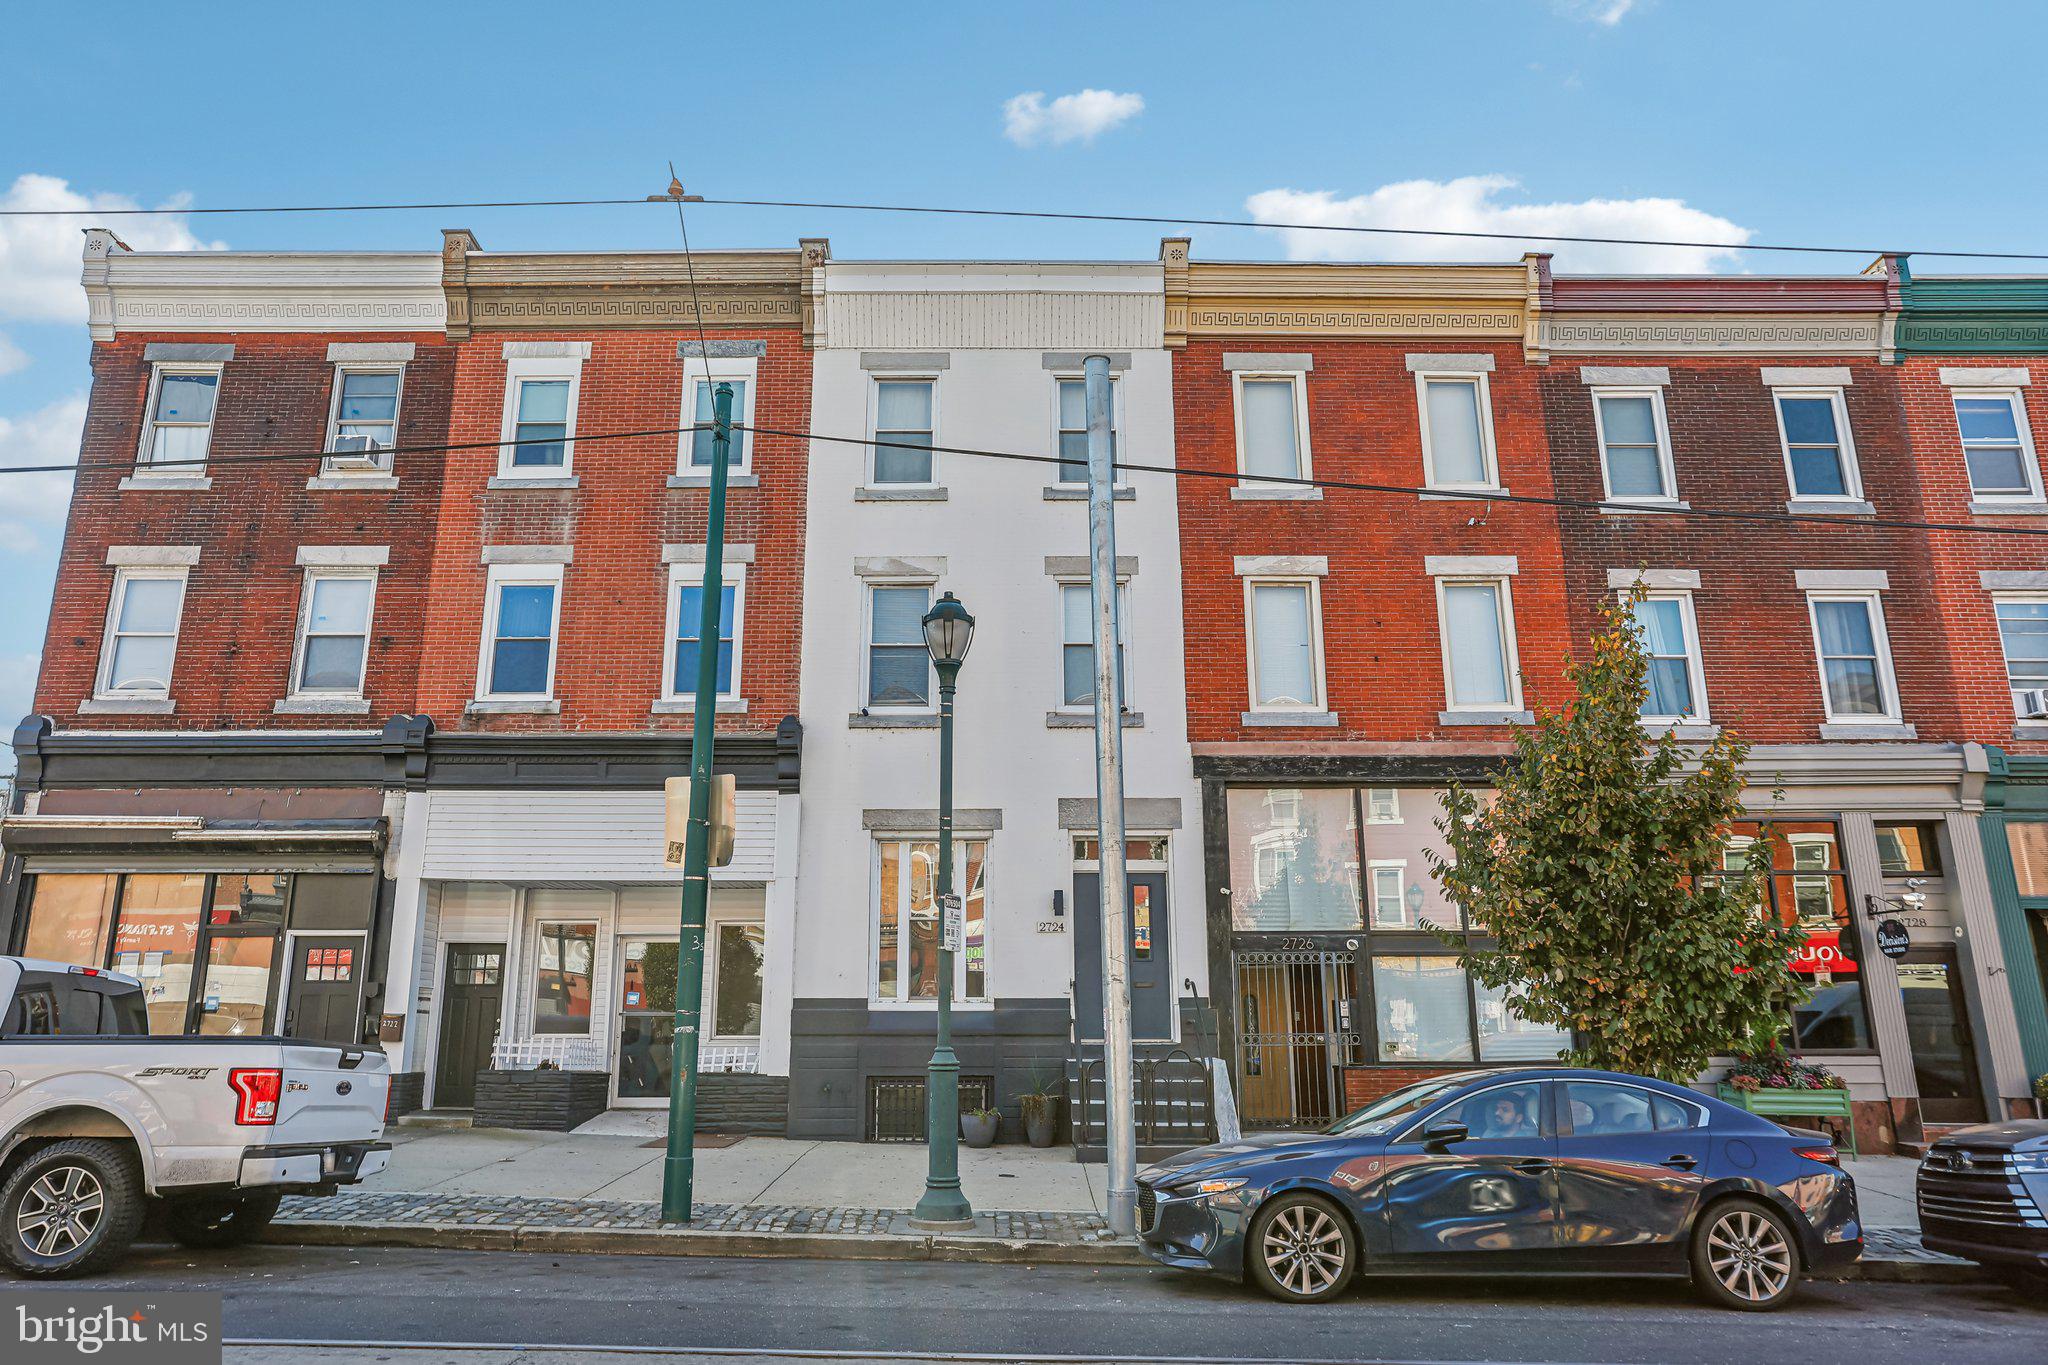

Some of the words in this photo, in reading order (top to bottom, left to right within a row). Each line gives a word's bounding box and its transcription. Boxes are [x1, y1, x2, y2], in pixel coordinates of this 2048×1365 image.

[1040, 922, 1064, 931] 2724
[1282, 937, 1315, 950] 2726
[382, 1020, 399, 1028] 2722
[135, 1067, 220, 1077] SPORT
